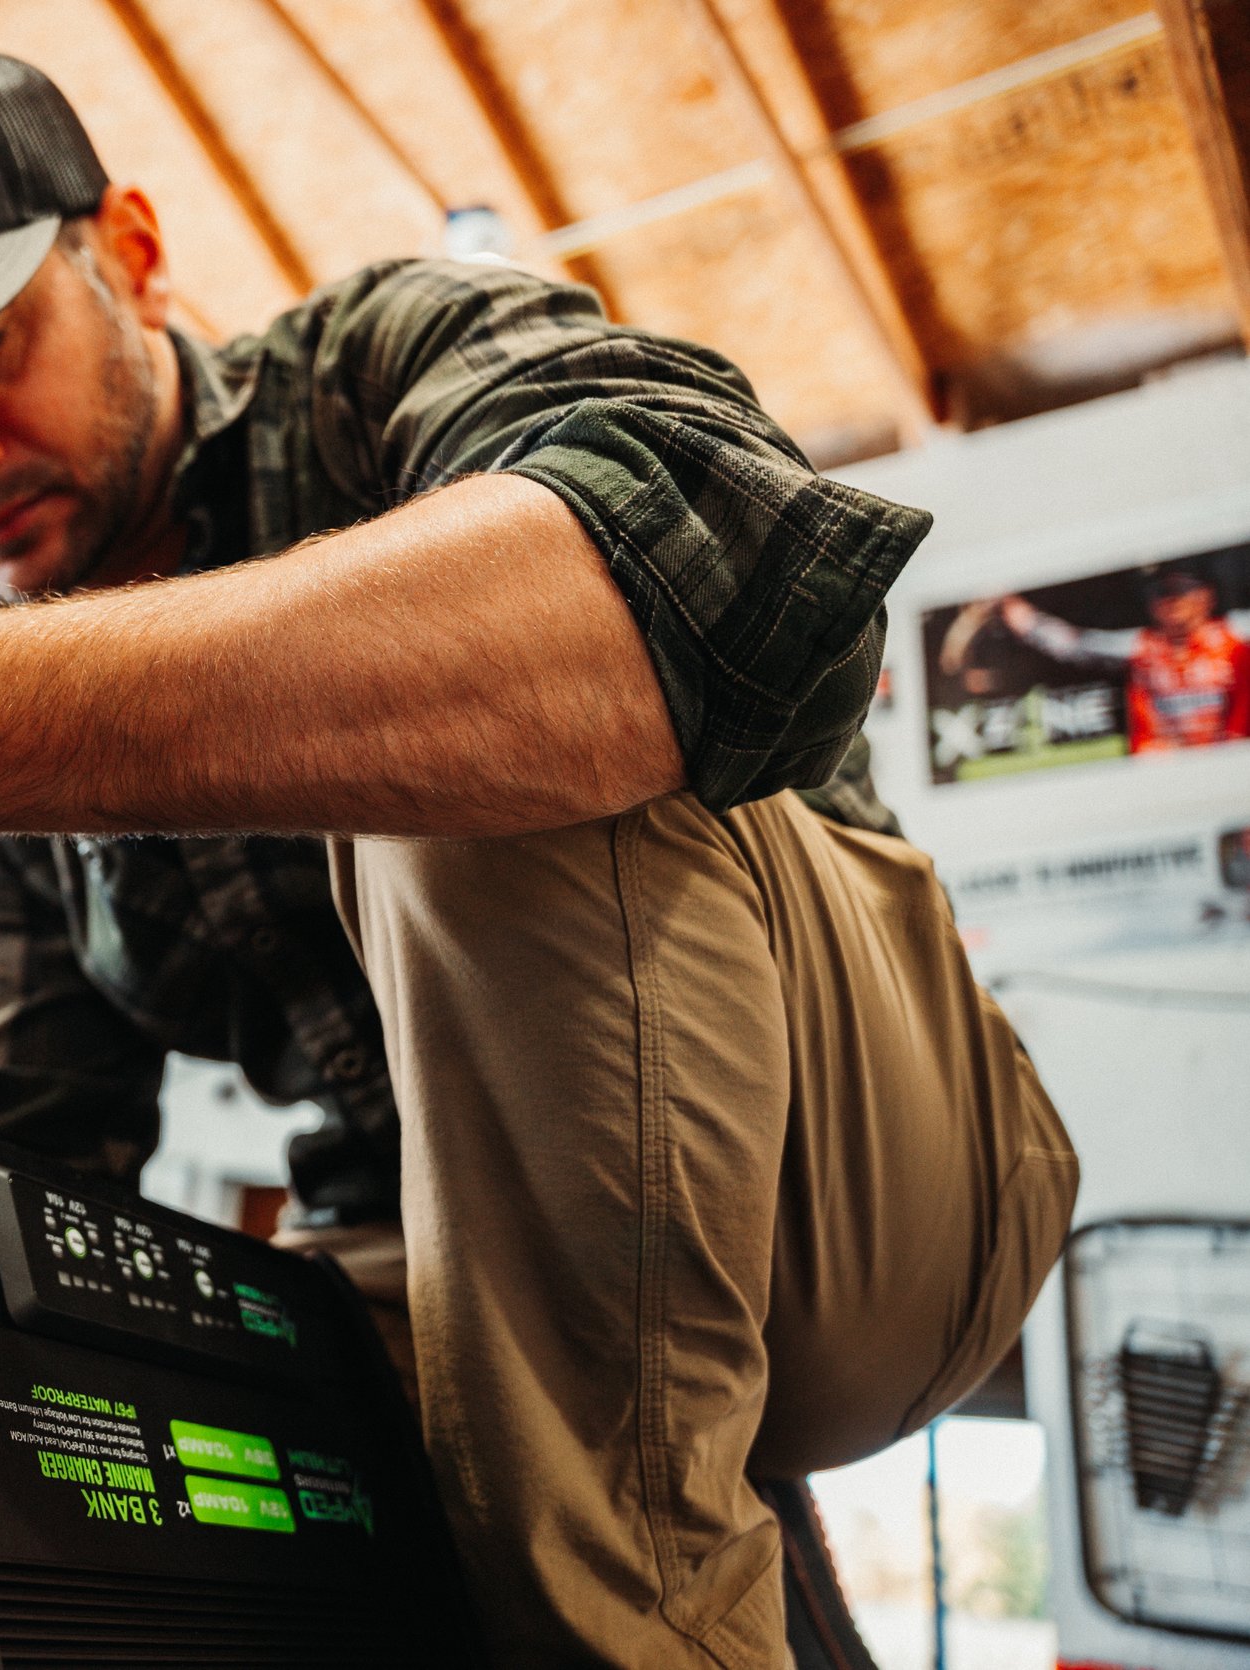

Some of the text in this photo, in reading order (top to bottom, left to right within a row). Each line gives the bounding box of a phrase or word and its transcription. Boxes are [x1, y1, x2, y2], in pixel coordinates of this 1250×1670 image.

[17, 1403, 44, 1417] Lithium
[31, 1384, 138, 1419] IP67 WATERPROOF
[43, 1407, 69, 1422] Voltage
[67, 1413, 82, 1425] Low
[33, 1418, 57, 1434] Battery
[106, 1434, 119, 1444] and
[87, 1444, 100, 1455] 12V
[162, 1443, 177, 1461] x1
[37, 1450, 156, 1493] MARINE CHARGER
[80, 1488, 163, 1526] 3 BANK
[176, 1500, 192, 1518] x2
[193, 1491, 249, 1513] 10AMP
